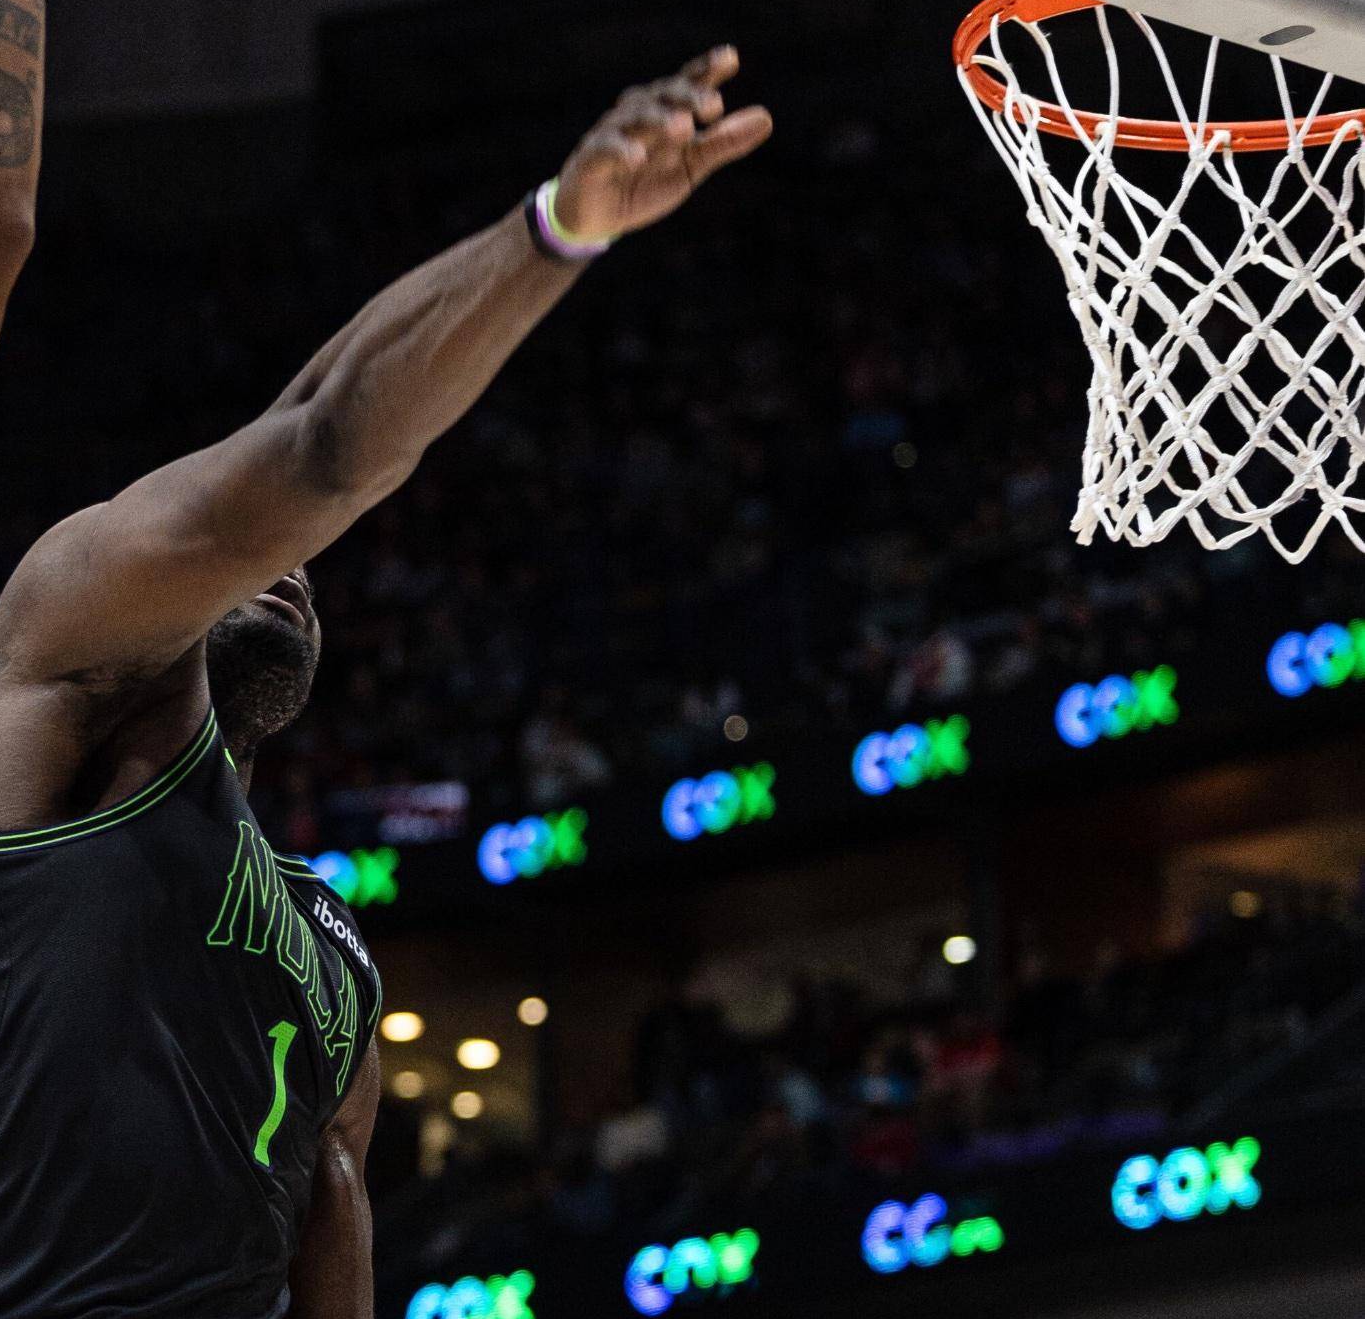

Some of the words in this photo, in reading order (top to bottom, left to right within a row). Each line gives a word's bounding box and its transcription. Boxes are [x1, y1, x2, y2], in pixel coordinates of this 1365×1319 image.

[1054, 664, 1179, 748] COX
[852, 714, 971, 796] COX
[662, 761, 776, 841] COX
[477, 807, 589, 885] COX
[313, 895, 369, 968] ibotta
[254, 1020, 299, 1167] 1
[1111, 1137, 1262, 1229] COX
